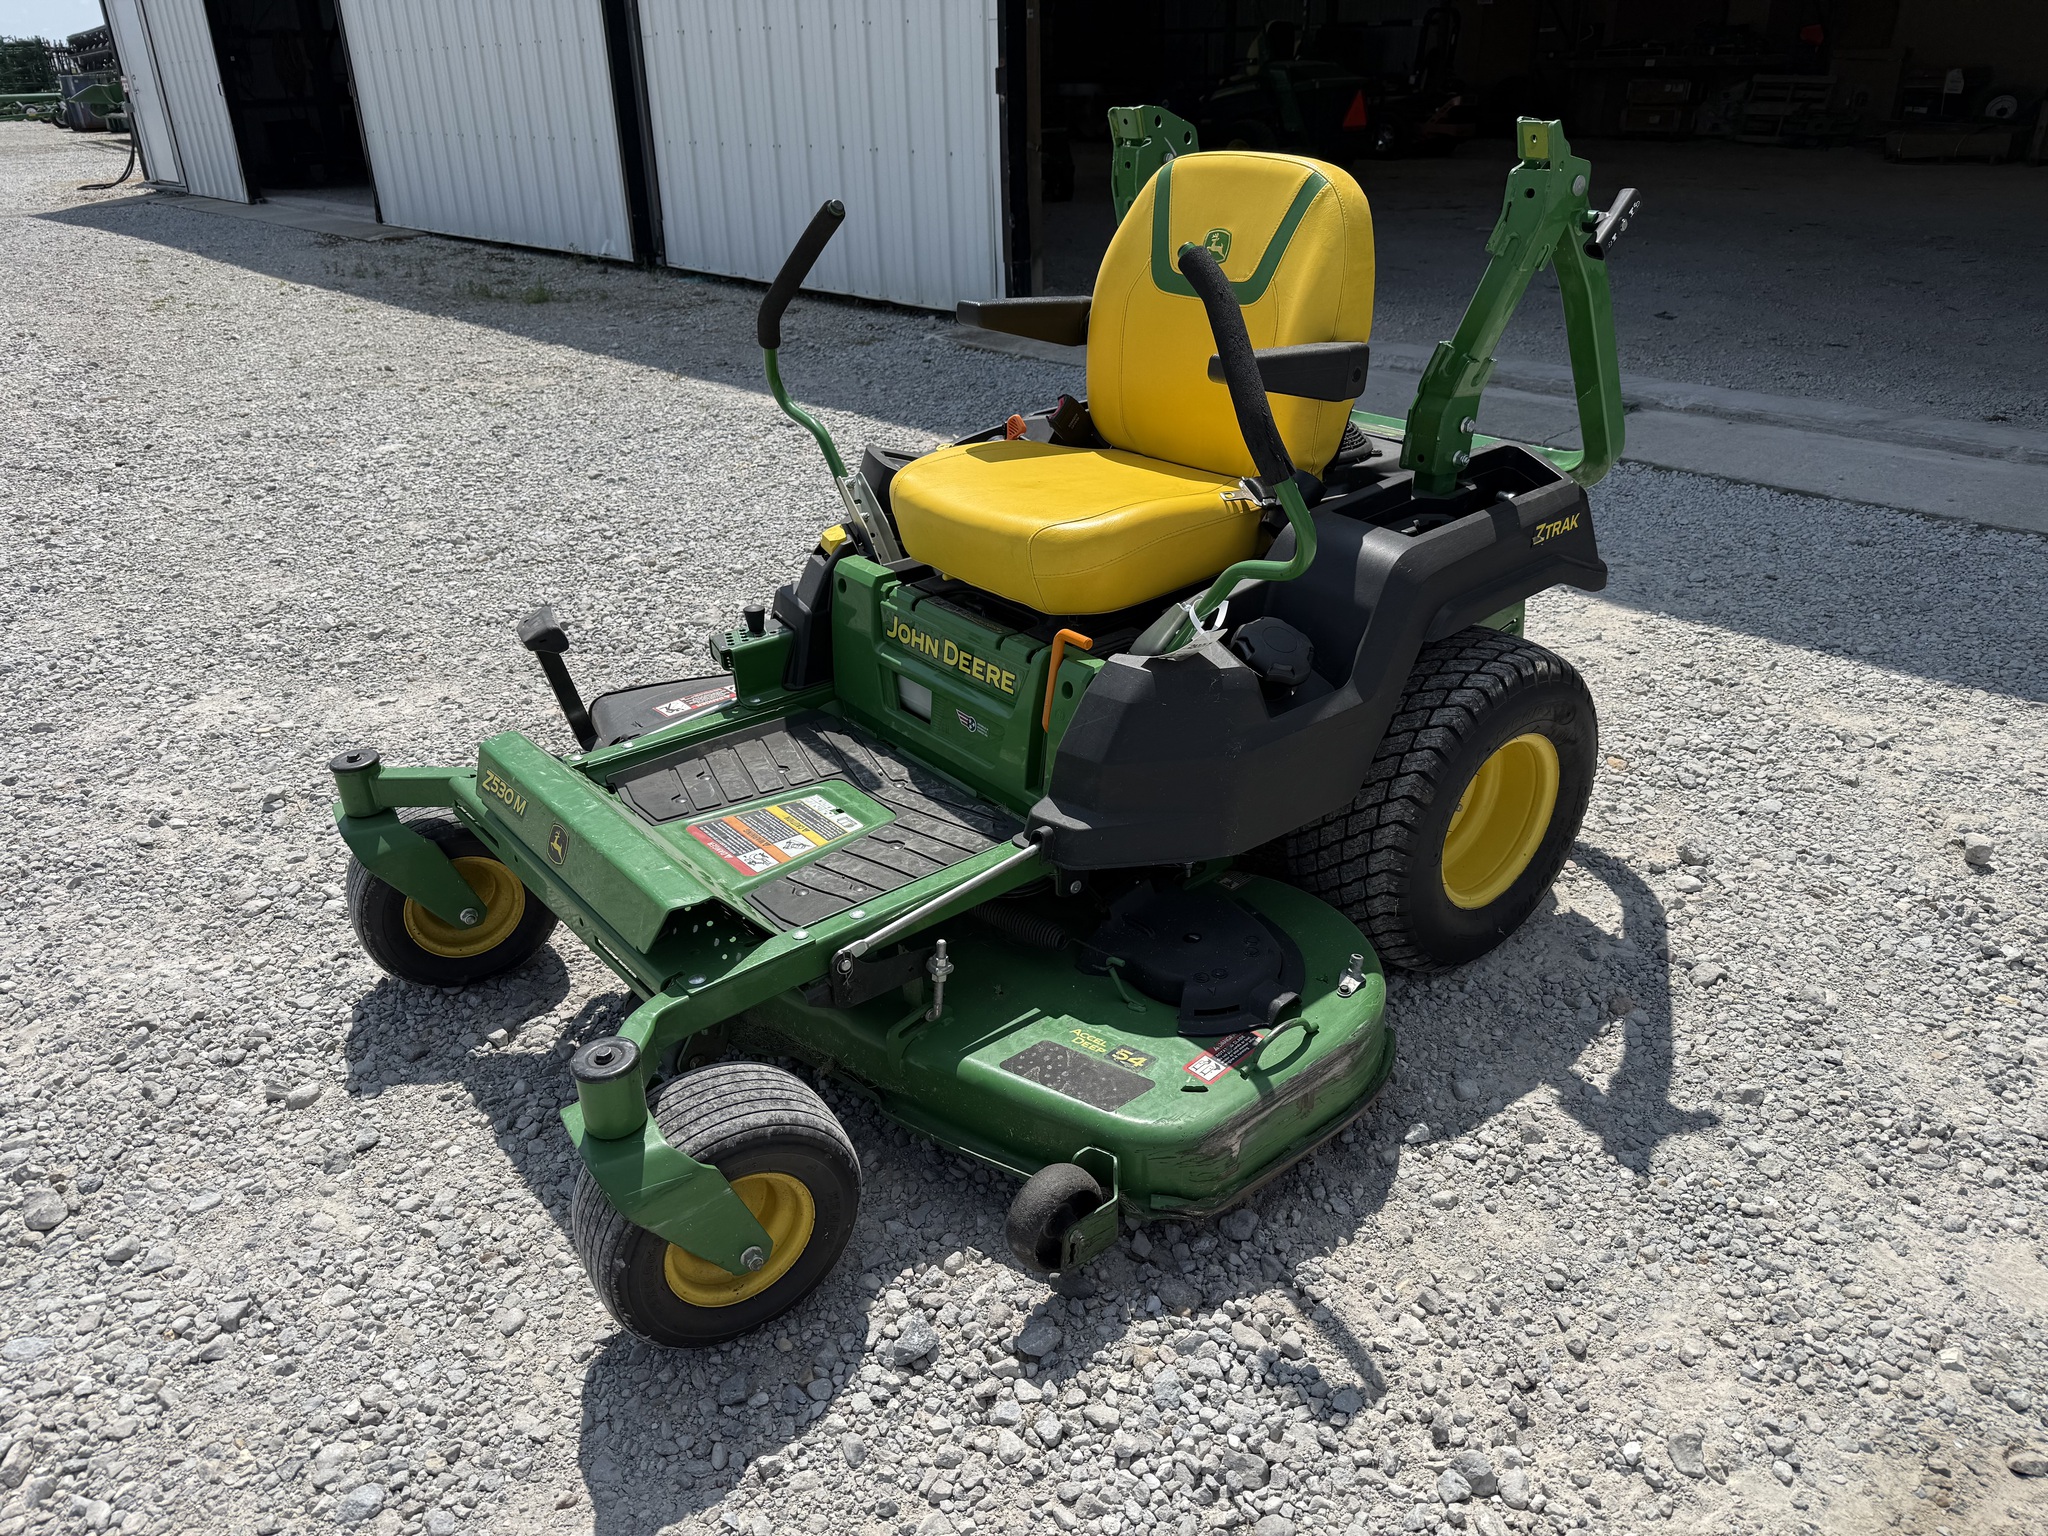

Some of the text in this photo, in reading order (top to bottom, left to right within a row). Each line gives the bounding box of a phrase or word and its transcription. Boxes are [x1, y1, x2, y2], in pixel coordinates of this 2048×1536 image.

[887, 616, 939, 659] JOHN
[943, 640, 1016, 695] DEERE
[482, 769, 527, 816] Z530 M
[707, 840, 726, 857] DANGER
[1071, 1029, 1107, 1048] ACCEL
[1071, 1036, 1108, 1054] DEEP
[1112, 1048, 1148, 1068] 54
